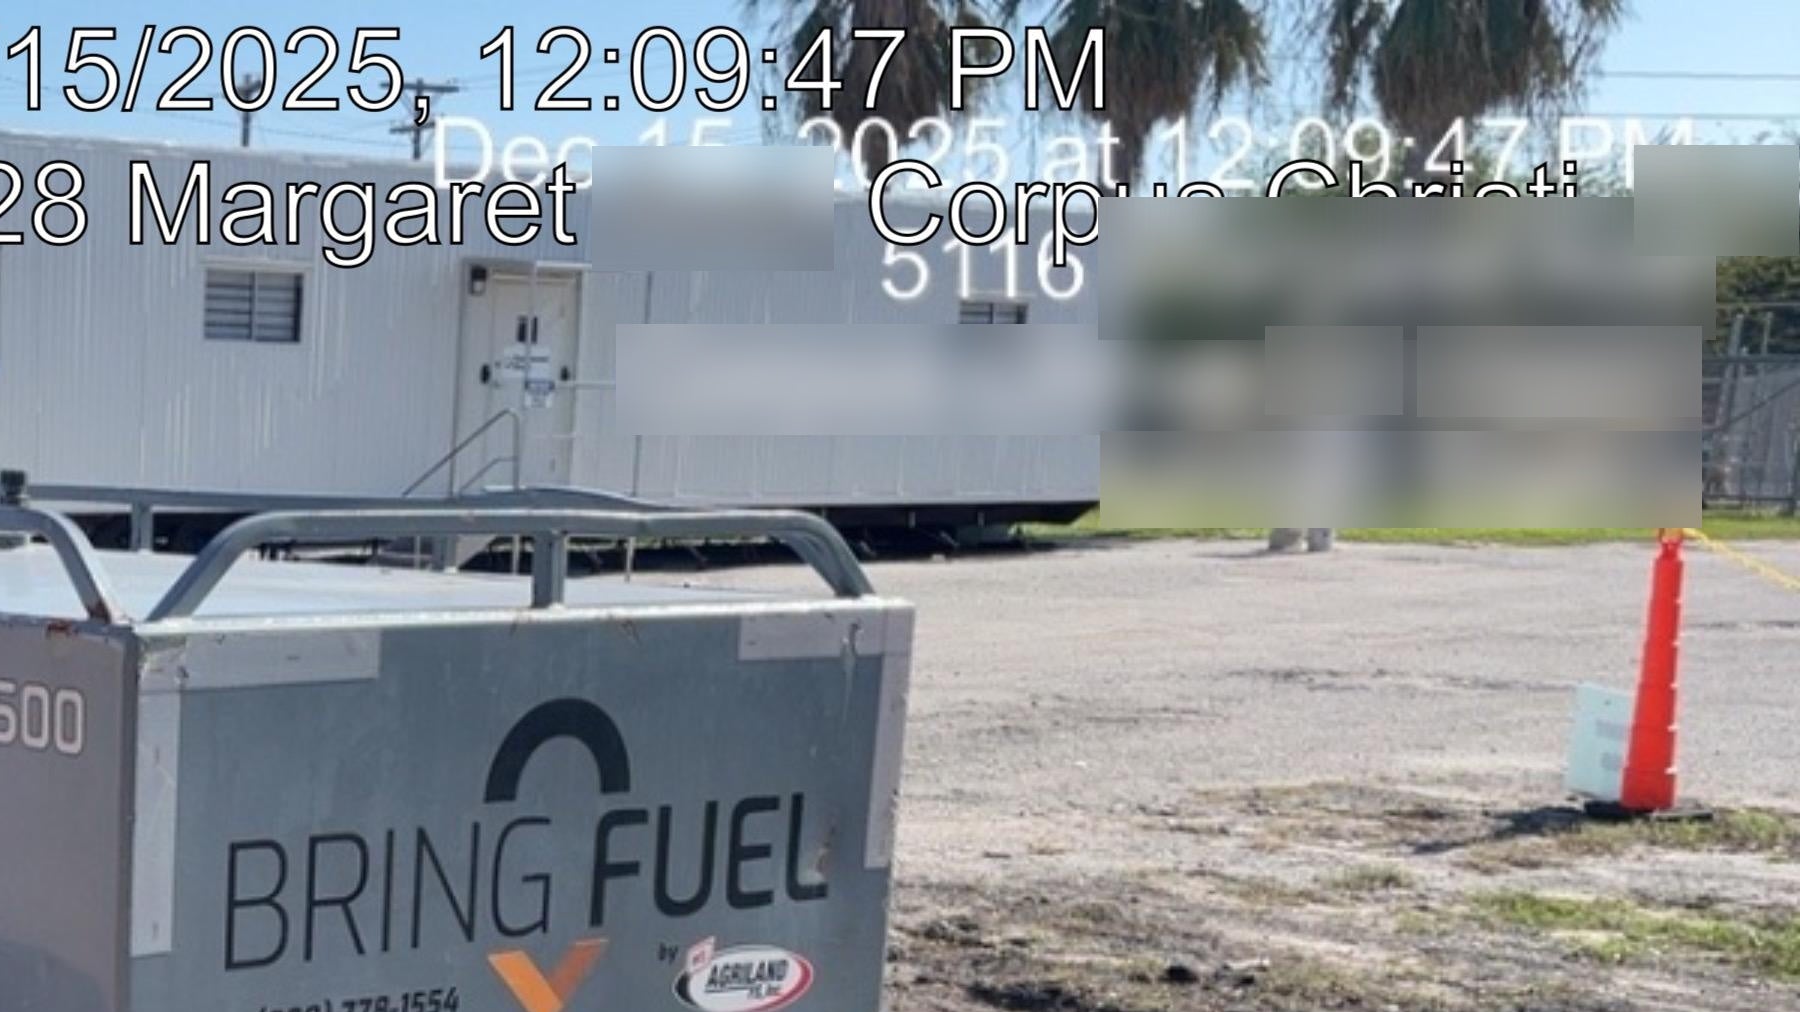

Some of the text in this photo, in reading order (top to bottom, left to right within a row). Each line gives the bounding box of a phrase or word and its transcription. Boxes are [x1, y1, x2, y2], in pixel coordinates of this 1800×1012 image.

[224, 791, 830, 972] BRING FUEL
[657, 942, 679, 964] by
[705, 958, 789, 988] AGRILAND
